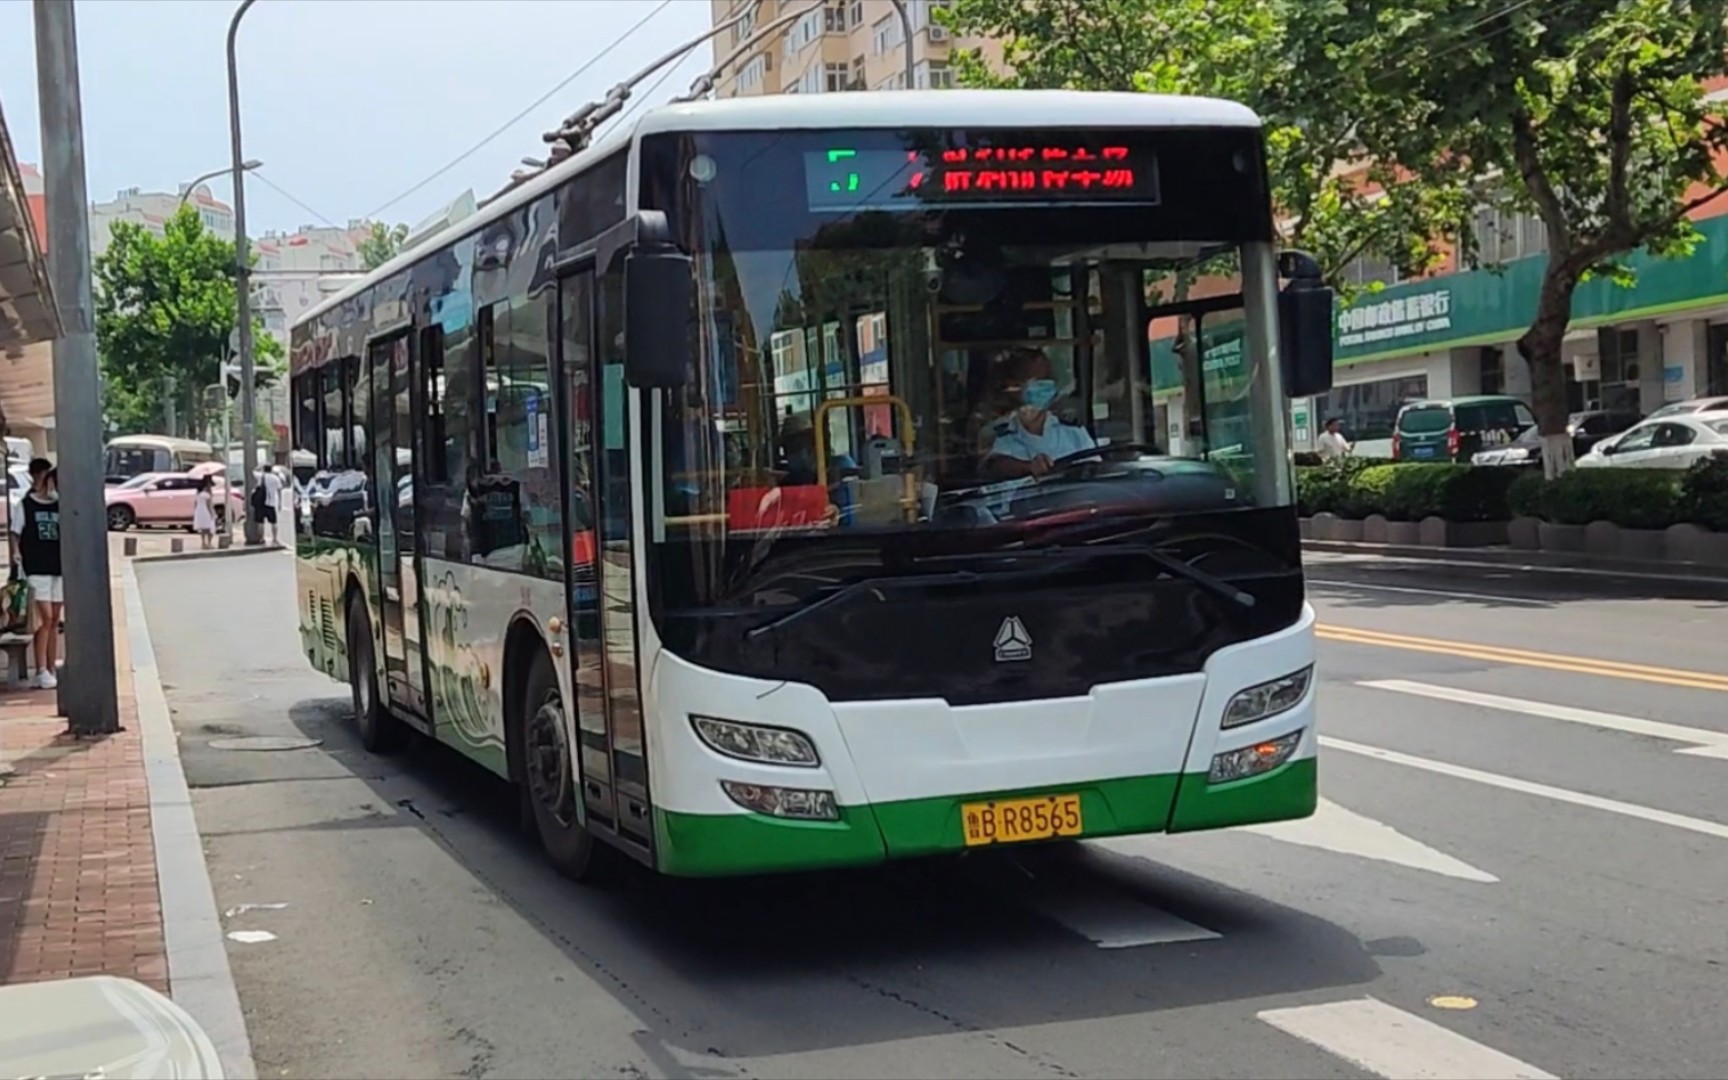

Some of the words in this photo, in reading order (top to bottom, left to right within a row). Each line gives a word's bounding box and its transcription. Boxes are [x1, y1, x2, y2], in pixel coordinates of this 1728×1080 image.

[1338, 289, 1451, 334] 中国邮政储蓄银行
